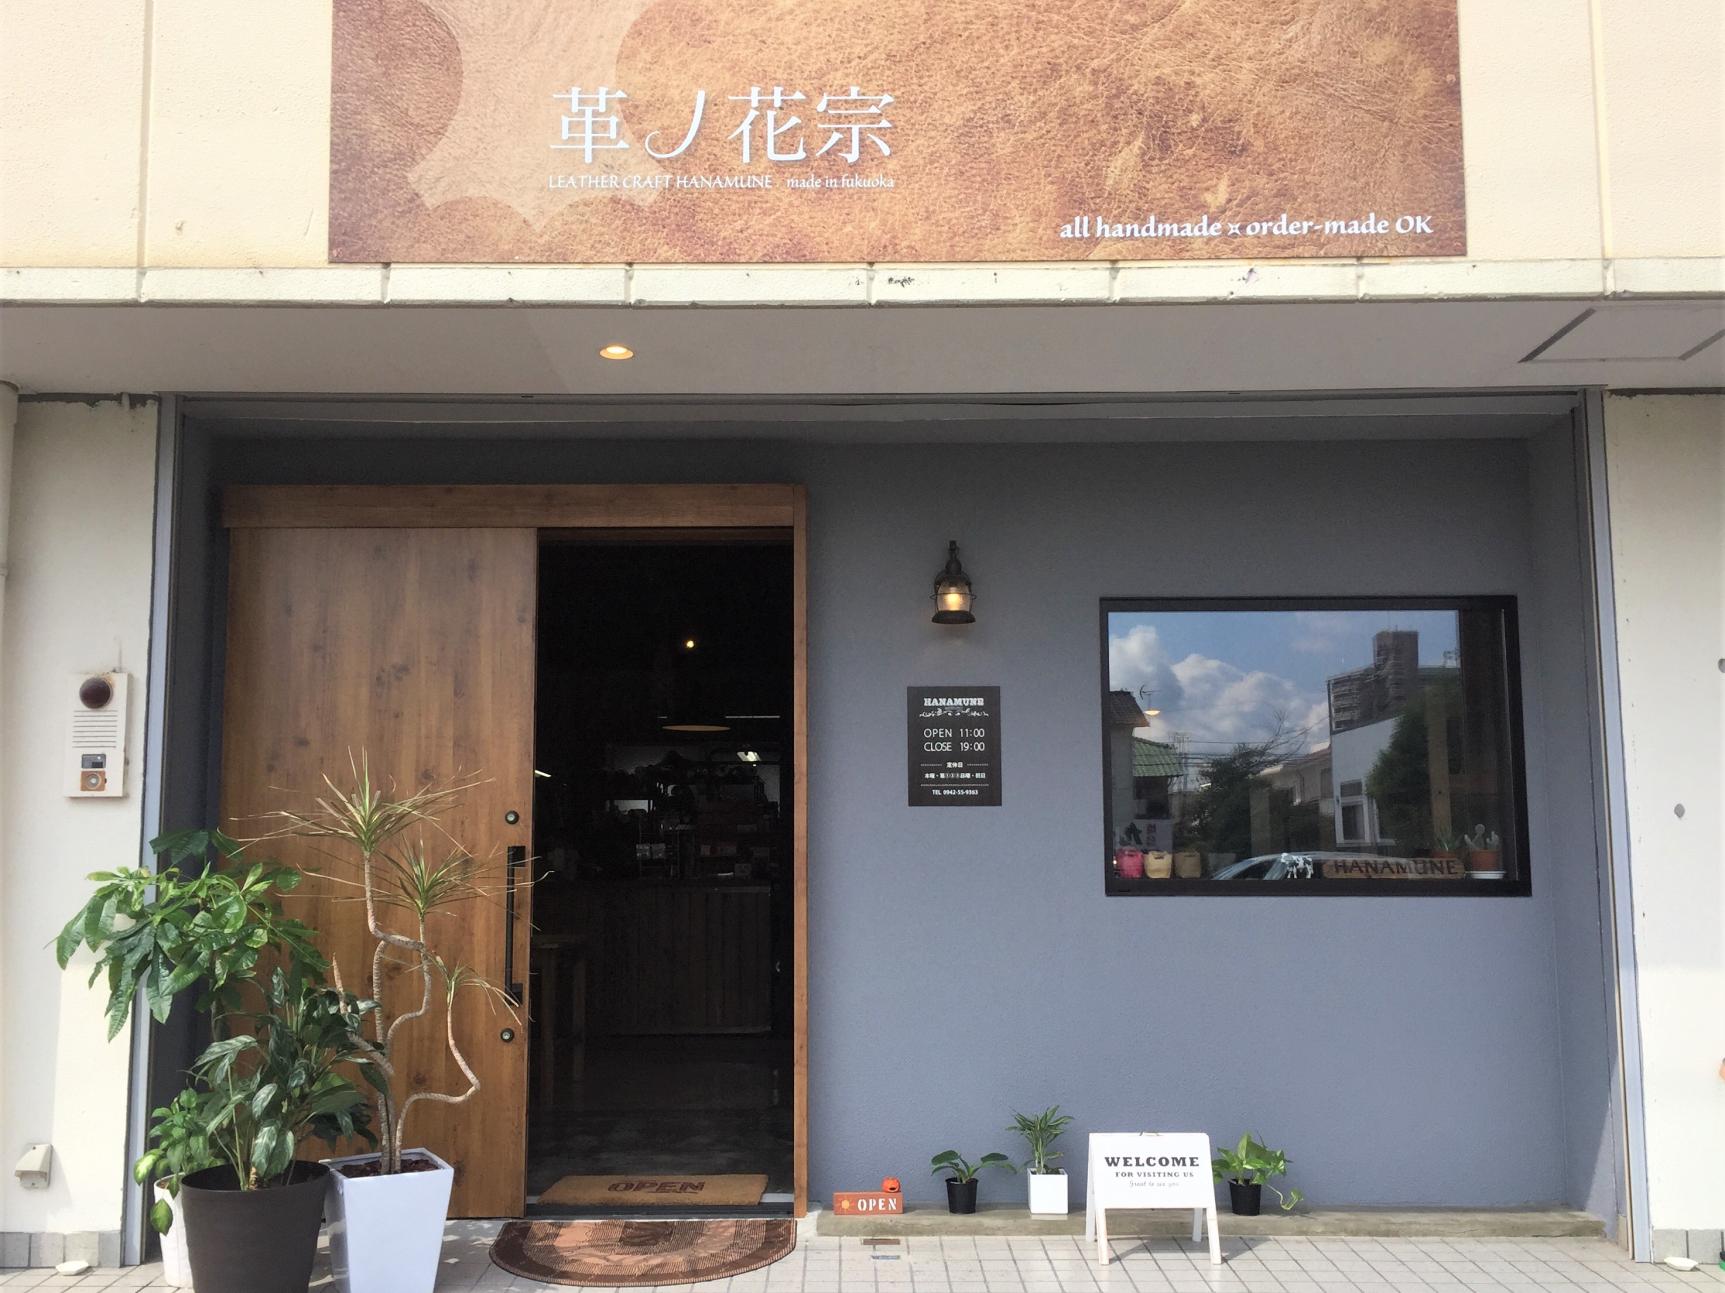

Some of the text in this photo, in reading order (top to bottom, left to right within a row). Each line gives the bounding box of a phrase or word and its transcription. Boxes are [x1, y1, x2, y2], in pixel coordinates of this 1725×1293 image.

[550, 86, 895, 164] 革ノ花宗
[549, 175, 773, 188] LEATHER CRAFT HANAMUNE
[786, 173, 895, 188] made in fukuoka
[1060, 216, 1090, 239] all
[1096, 215, 1222, 238] handmade
[1246, 213, 1390, 236] order-made
[1395, 215, 1434, 235] OK
[923, 697, 985, 706] HANAMUNE
[923, 728, 985, 739] OPEN 11:00
[923, 741, 985, 752] CLOSE 19:00
[1333, 859, 1459, 875] HANAMUNE
[1104, 1156, 1200, 1167] WELCOME
[606, 1180, 706, 1194] OPEN
[857, 1198, 897, 1211] OPEN
